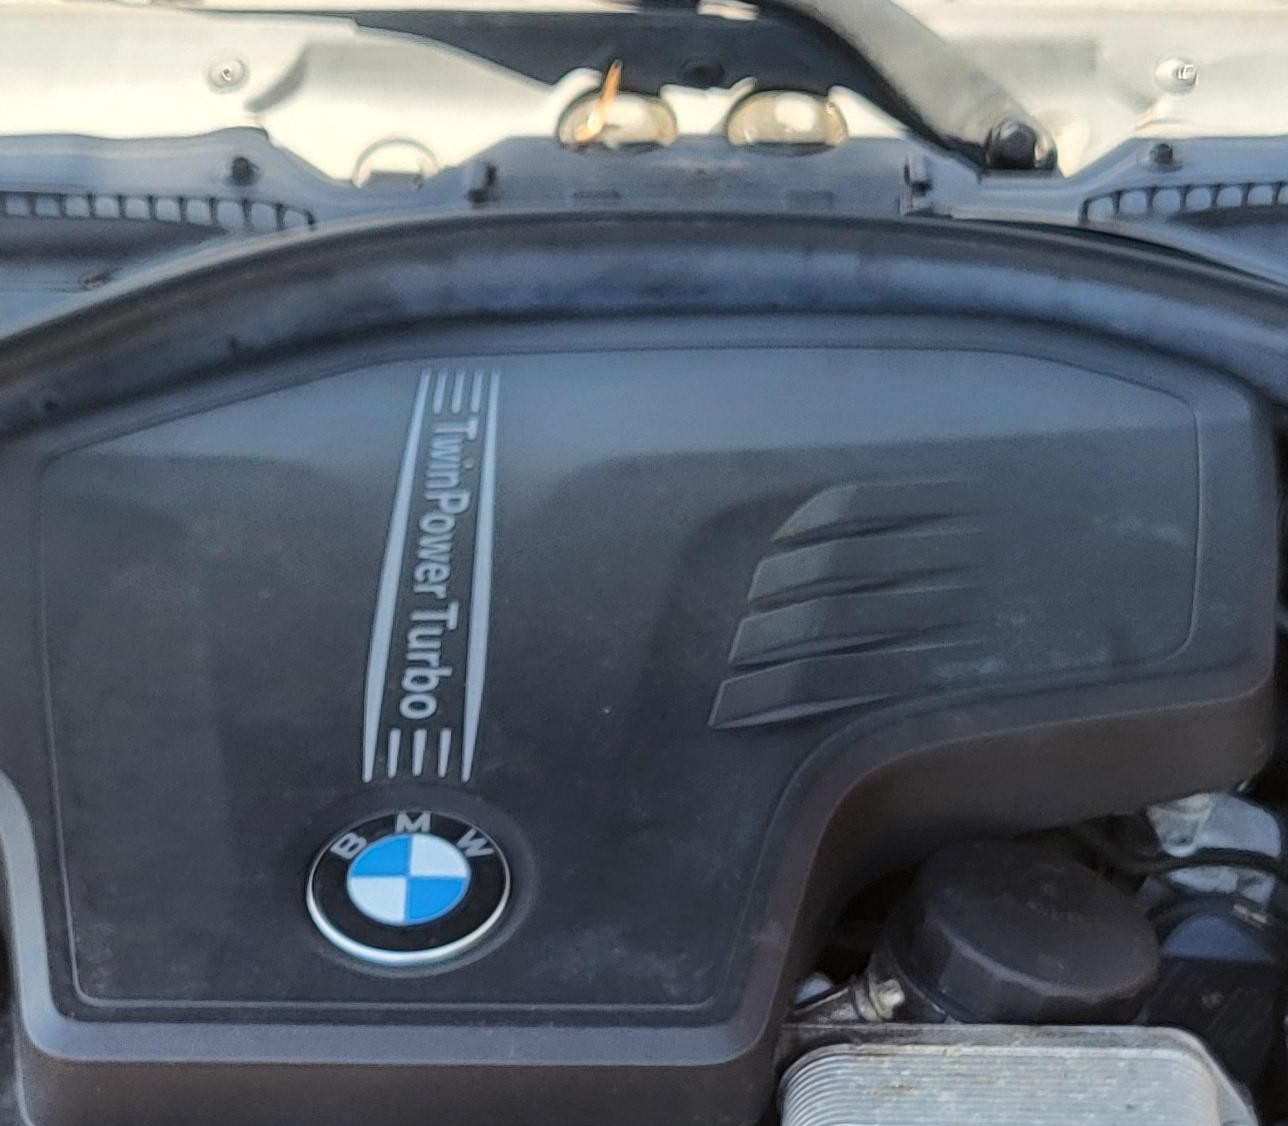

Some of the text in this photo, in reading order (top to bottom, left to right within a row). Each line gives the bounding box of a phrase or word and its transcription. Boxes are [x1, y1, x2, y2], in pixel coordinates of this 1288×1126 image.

[399, 417, 478, 720] TwinPower Turbo
[330, 810, 495, 860] BMW
